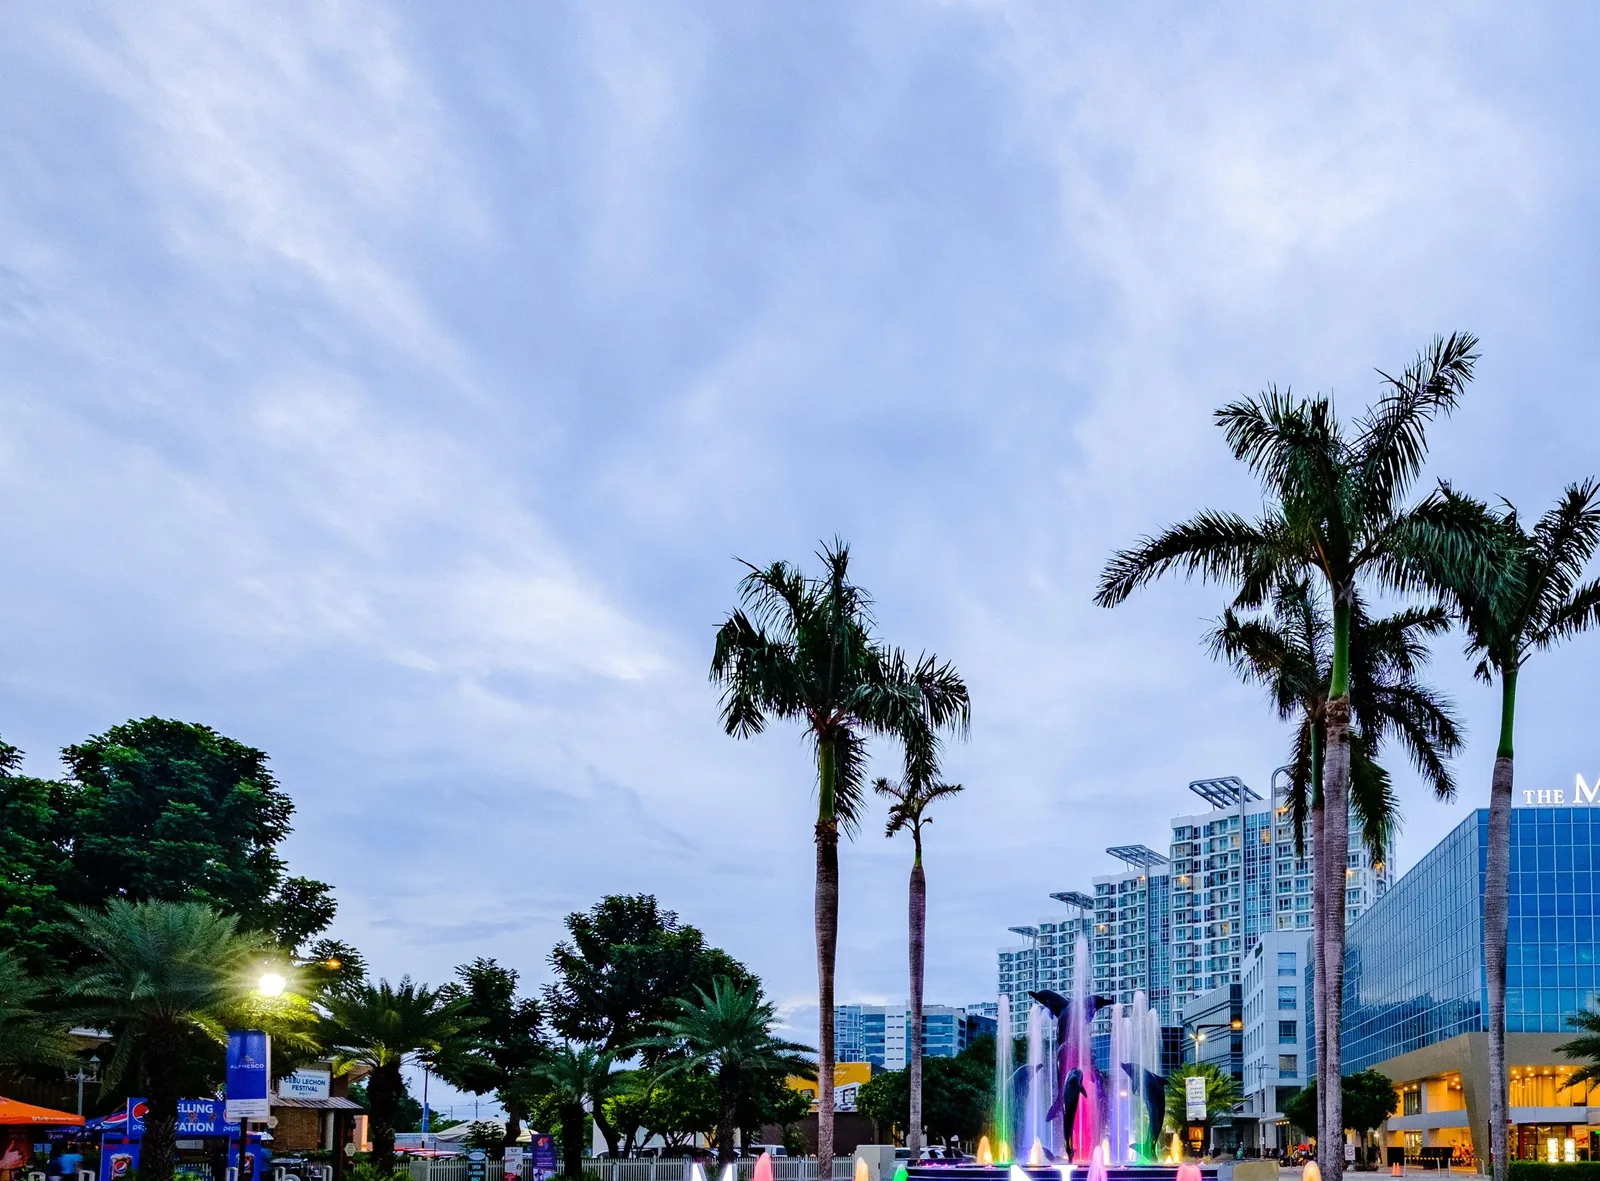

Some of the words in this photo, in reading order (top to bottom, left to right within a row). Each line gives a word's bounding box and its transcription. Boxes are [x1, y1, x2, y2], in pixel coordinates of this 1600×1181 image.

[1522, 789, 1564, 804] THE
[284, 1077, 301, 1085] CEBU
[291, 1085, 319, 1093] FESTIVAL
[177, 1103, 214, 1114] ELLING
[175, 1122, 215, 1132] ATION
[223, 1125, 241, 1133] peps
